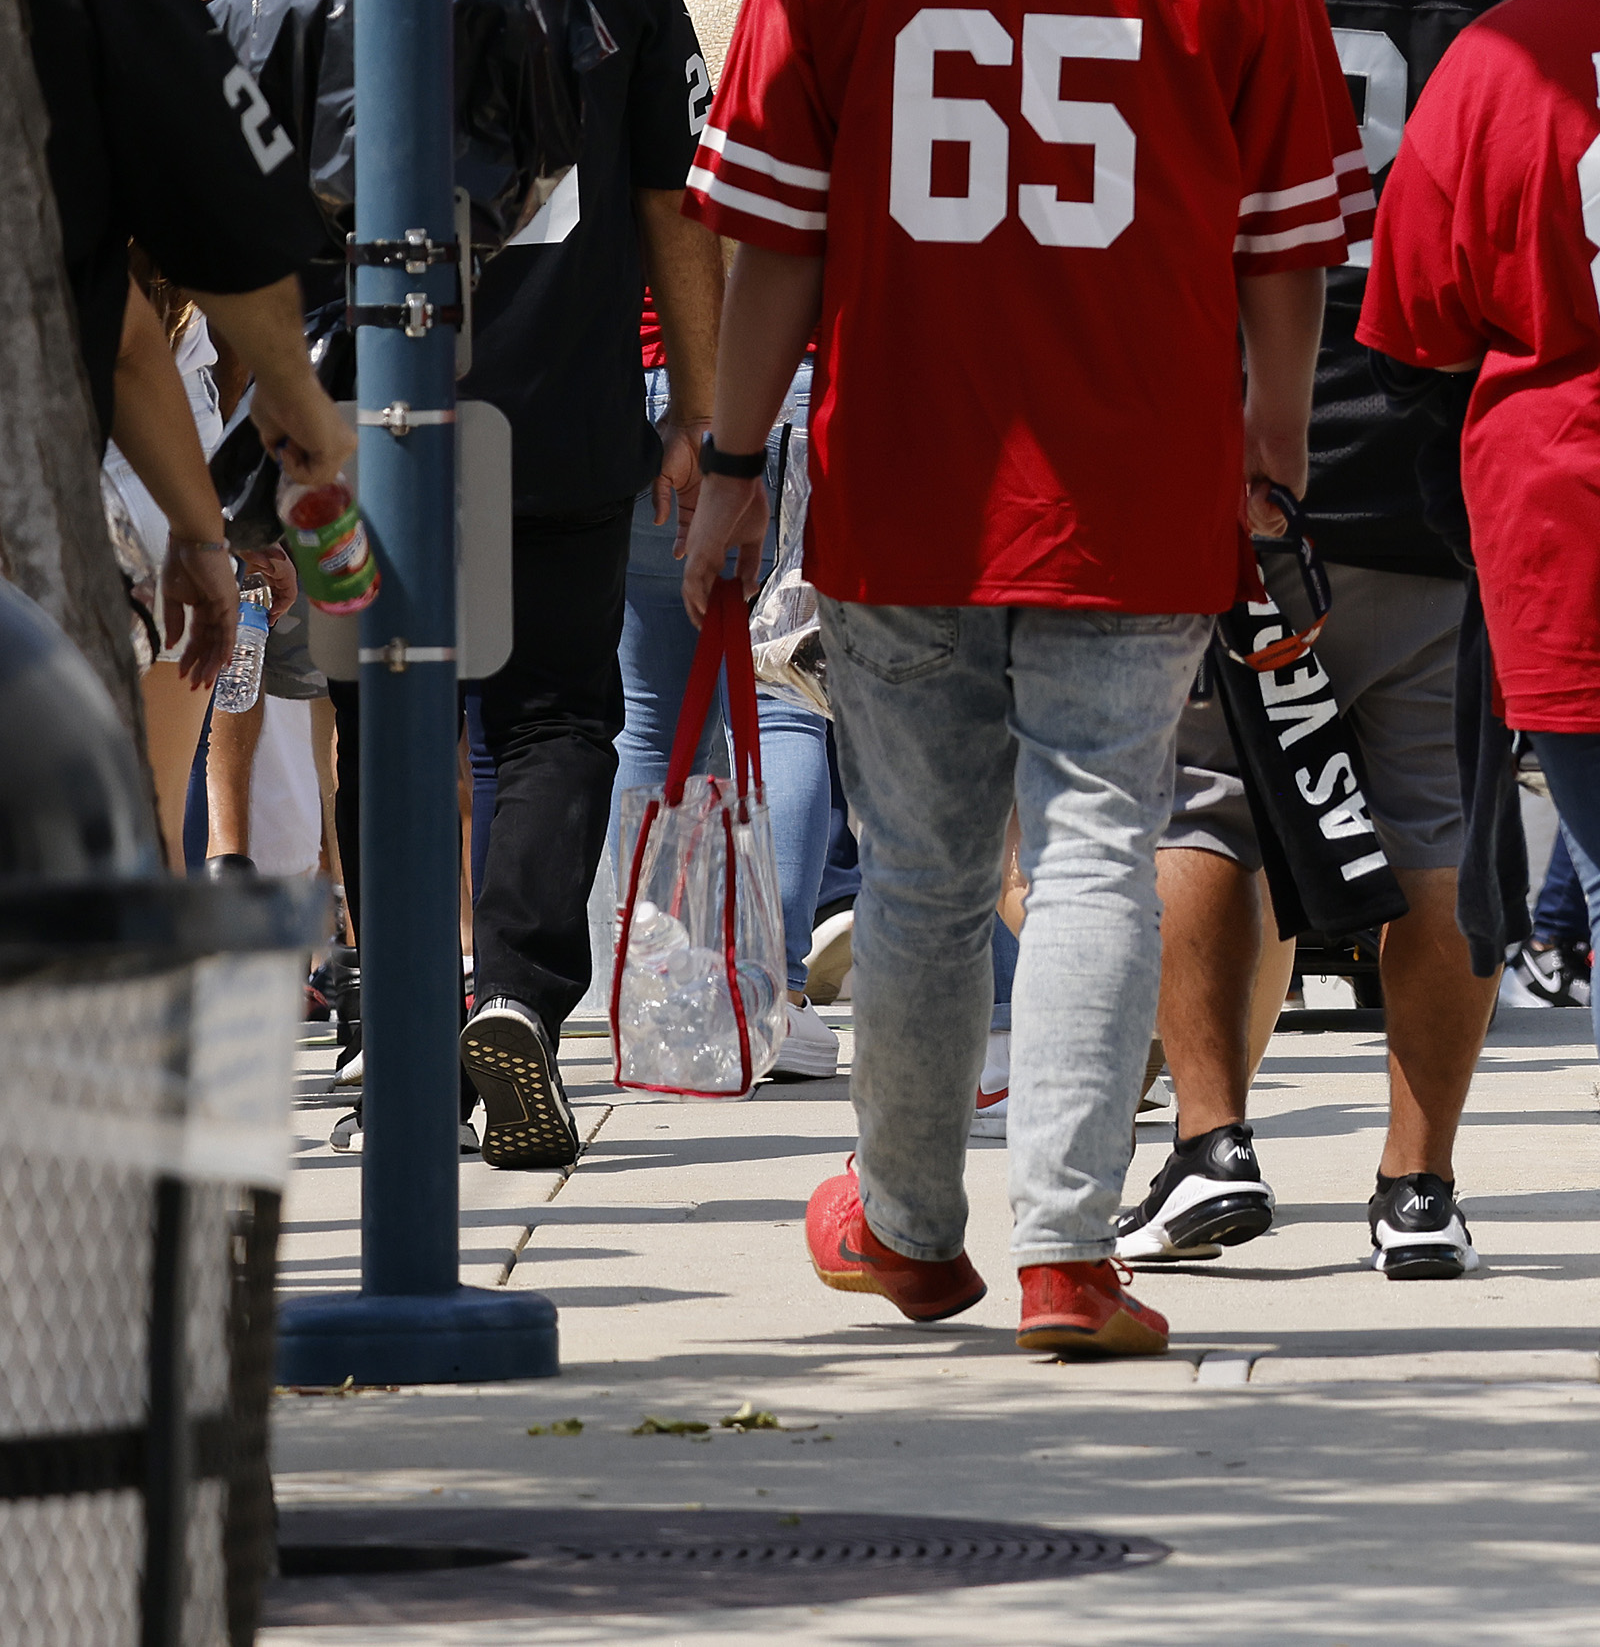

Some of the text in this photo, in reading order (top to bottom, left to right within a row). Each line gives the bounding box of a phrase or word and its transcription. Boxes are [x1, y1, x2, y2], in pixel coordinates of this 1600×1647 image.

[222, 65, 296, 176] 2
[685, 52, 713, 137] 2
[889, 8, 1144, 248] 65
